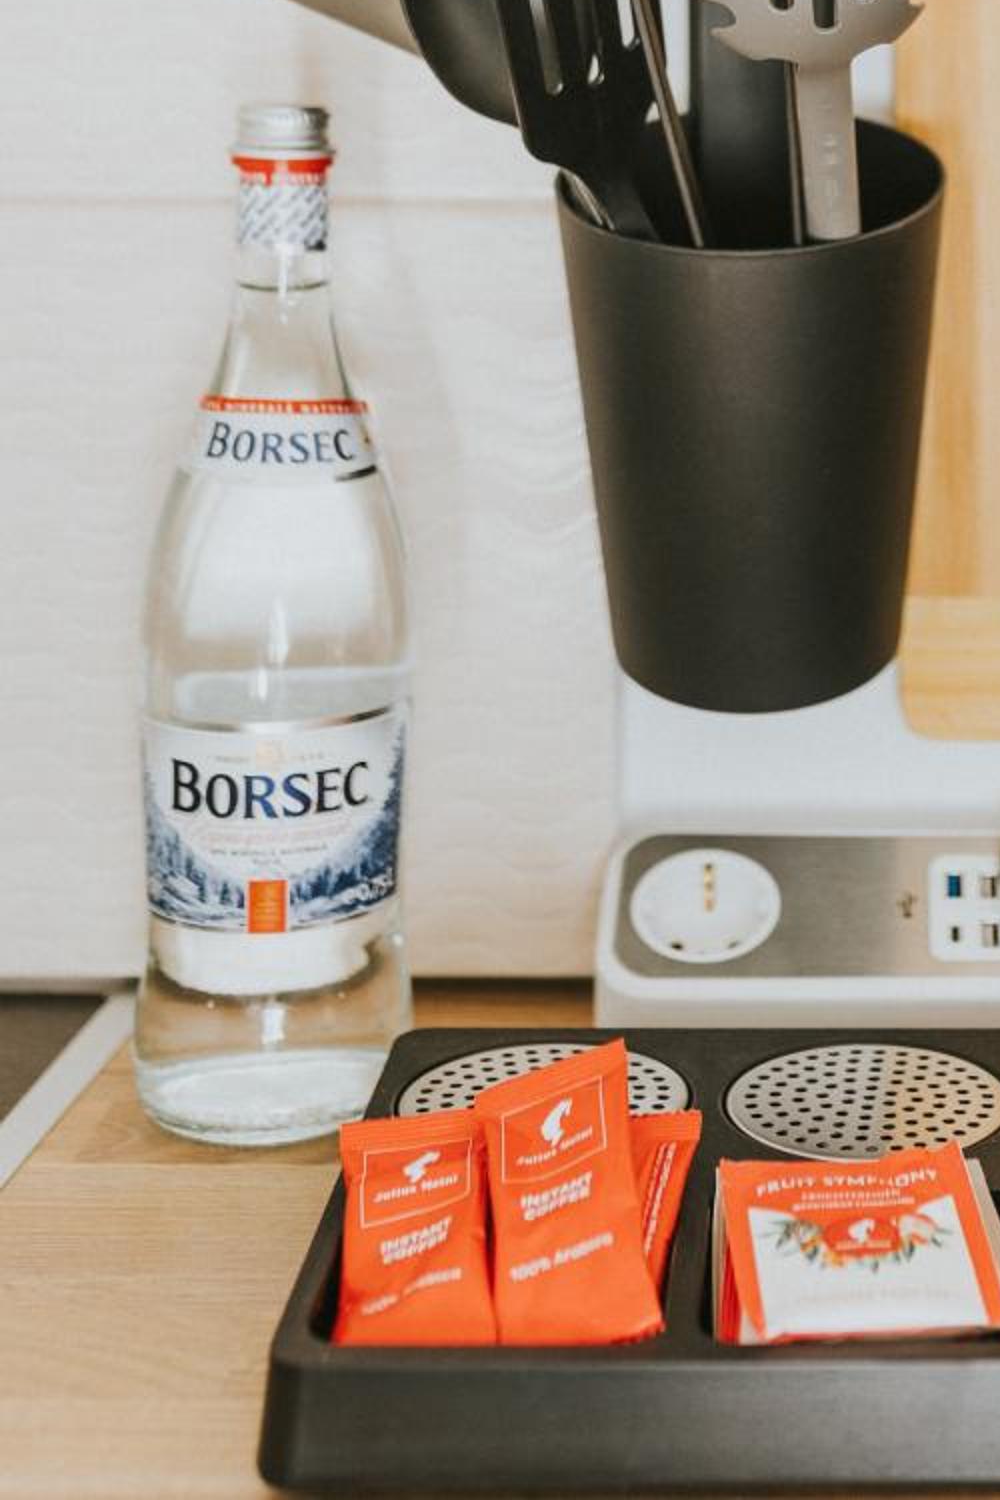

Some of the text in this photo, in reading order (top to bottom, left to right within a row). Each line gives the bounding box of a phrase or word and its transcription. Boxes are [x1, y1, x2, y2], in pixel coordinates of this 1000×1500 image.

[206, 420, 355, 464] BORSEC
[171, 757, 369, 819] BORSEC
[755, 1175, 816, 1198] FRUIT
